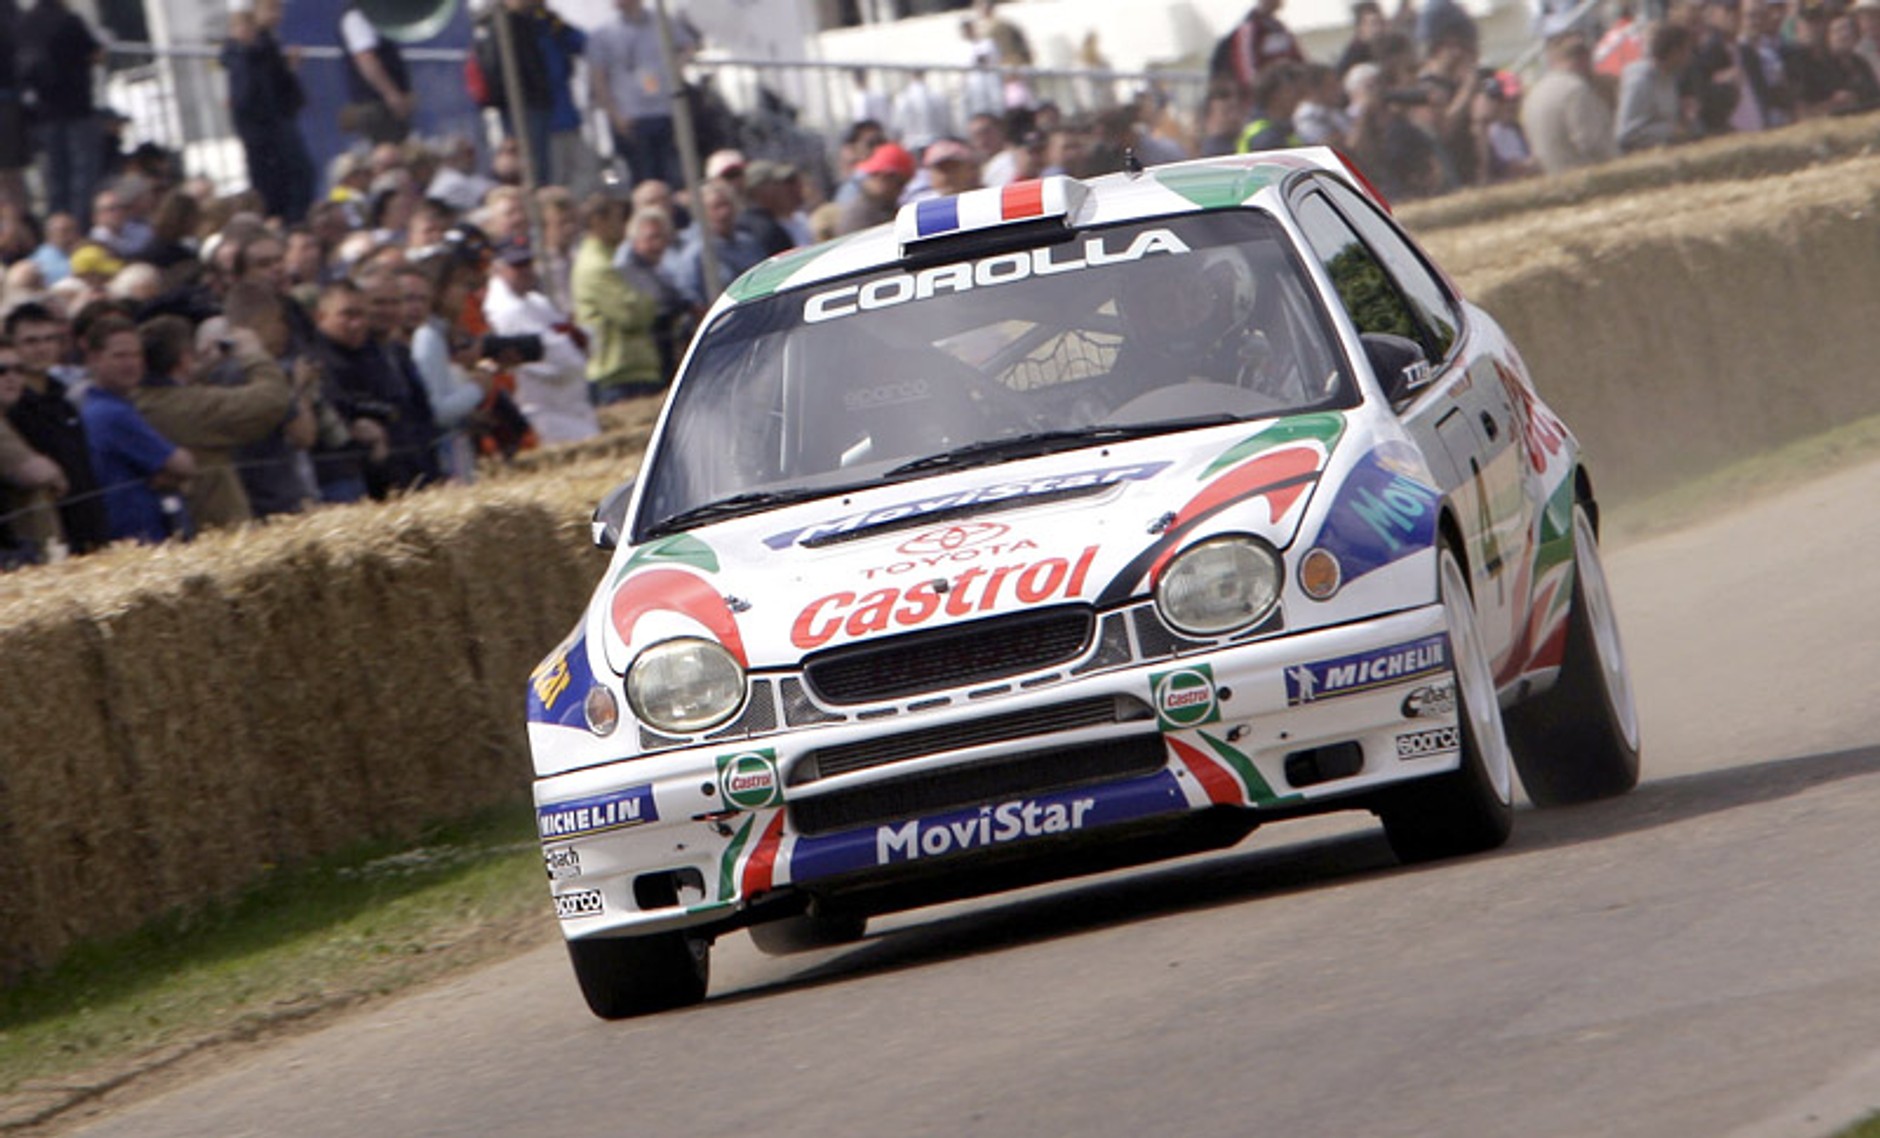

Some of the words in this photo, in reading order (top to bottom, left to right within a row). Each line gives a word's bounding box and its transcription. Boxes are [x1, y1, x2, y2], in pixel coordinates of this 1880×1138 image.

[803, 229, 1191, 324] COROLLA
[797, 464, 1144, 540] MoviStar
[861, 538, 1038, 579] TOYOTA
[790, 546, 1101, 650] Castrol
[1325, 642, 1444, 690] MICHELIN
[1168, 685, 1209, 707] Castrol
[731, 772, 772, 791] Castrol
[540, 797, 641, 836] MICHELIN
[876, 798, 1095, 866] MoviStar
